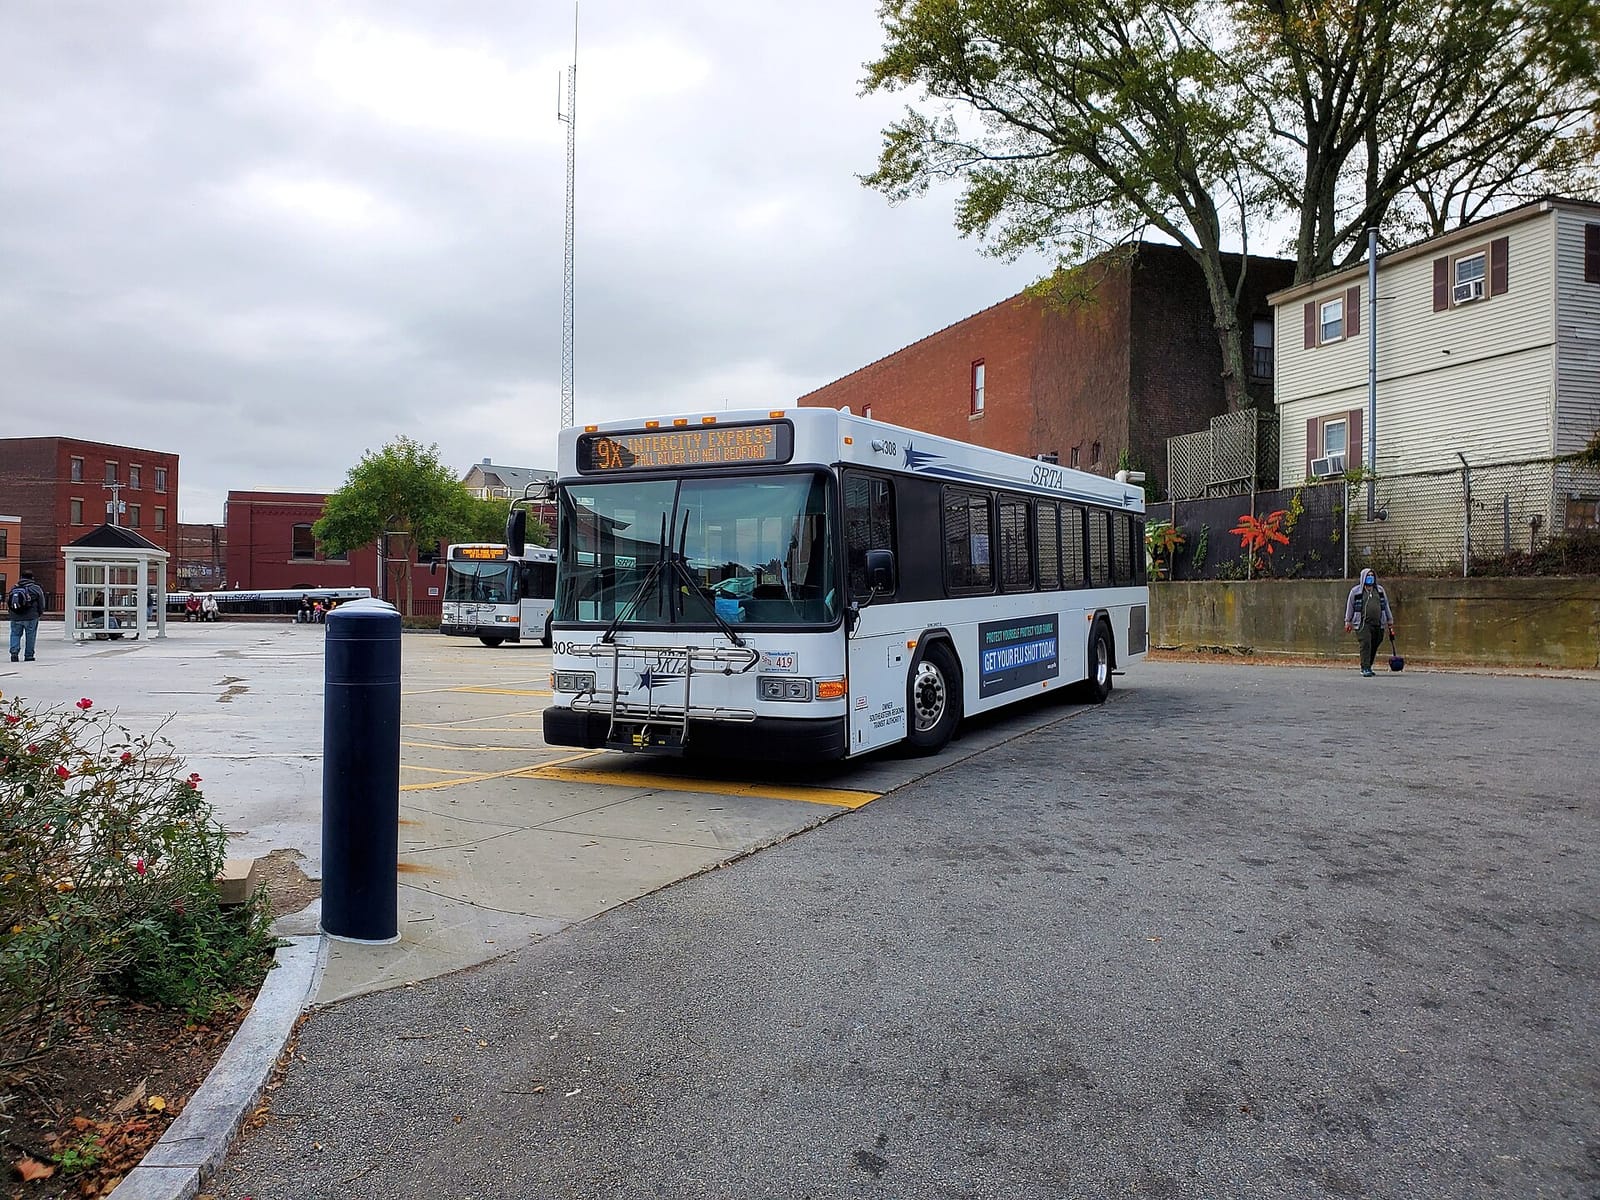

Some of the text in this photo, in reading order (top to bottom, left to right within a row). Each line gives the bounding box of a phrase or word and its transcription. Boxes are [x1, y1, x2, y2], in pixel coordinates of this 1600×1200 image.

[627, 427, 773, 453] INTERCITY EXPRESS
[597, 439, 623, 468] 9X
[634, 444, 766, 466] FALL RIVER TO NEW BEDFORD
[1030, 464, 1064, 490] SRTA
[776, 656, 793, 668] 419
[984, 652, 997, 671] GET
[997, 648, 1014, 668] YOUR
[1014, 646, 1024, 665] FLU
[1024, 643, 1039, 662] SHOT
